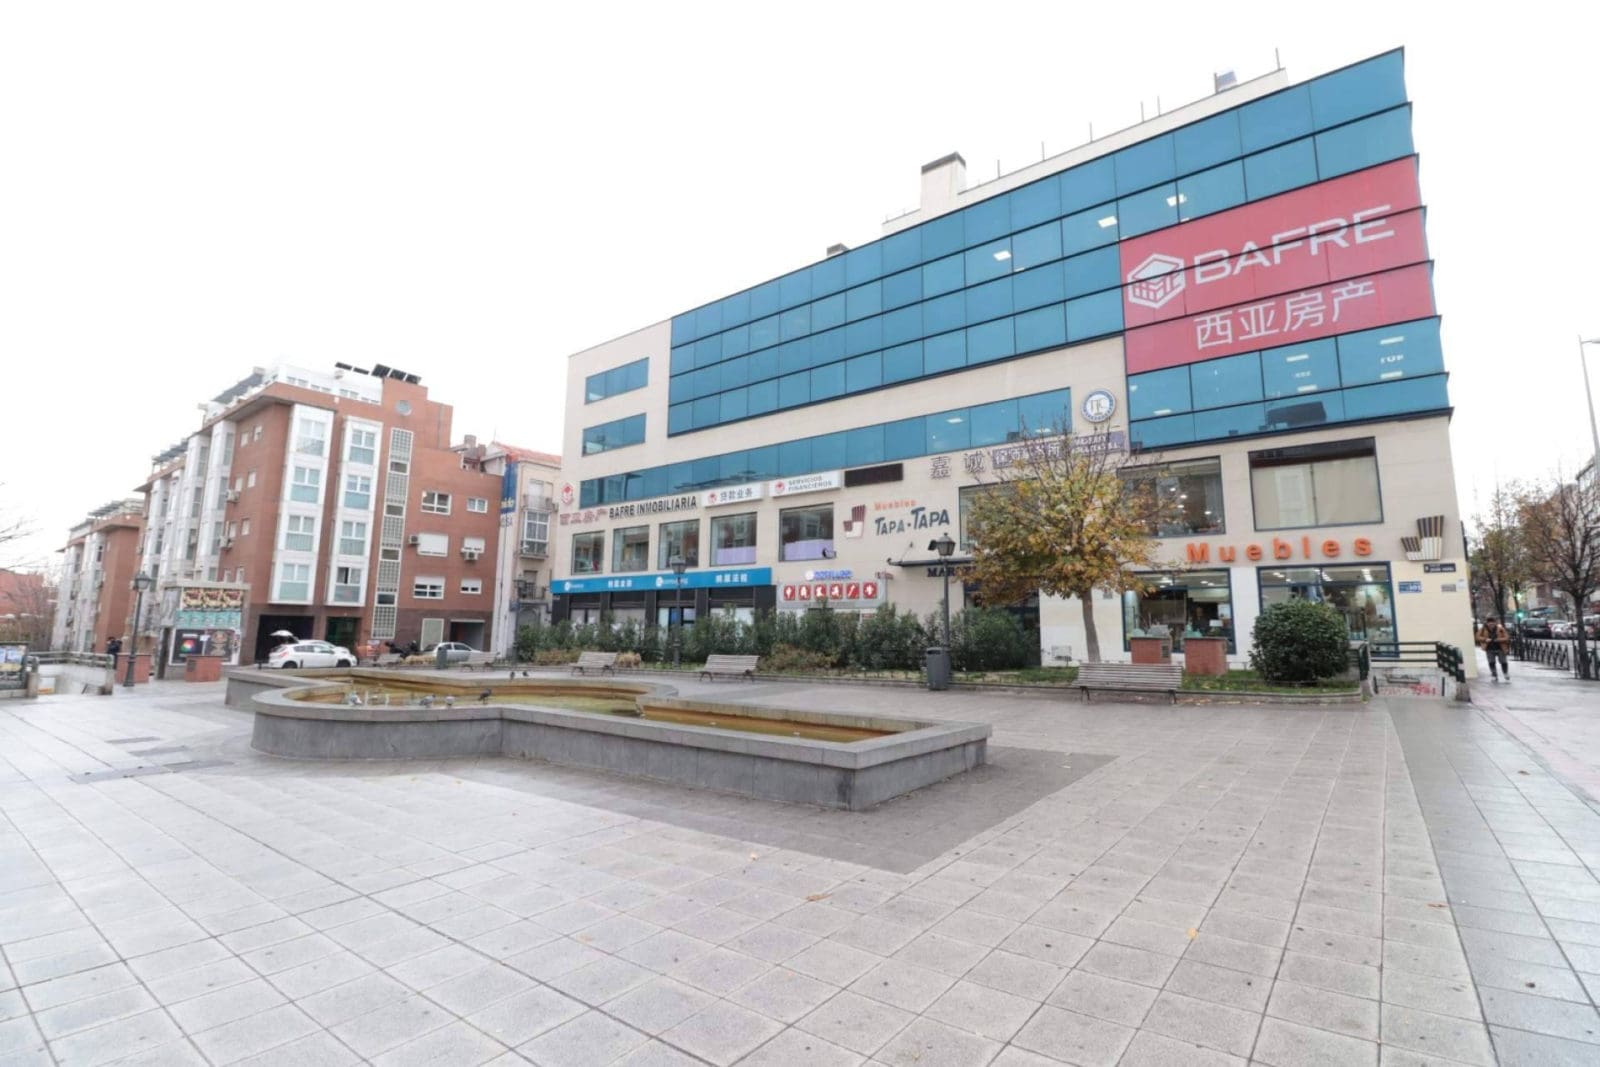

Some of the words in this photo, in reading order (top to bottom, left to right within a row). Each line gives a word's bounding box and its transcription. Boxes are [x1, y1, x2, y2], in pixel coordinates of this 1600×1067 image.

[1194, 204, 1396, 285] BAFRE
[1193, 280, 1376, 351] 西亚房产
[788, 475, 823, 486] SERVICIOS
[788, 480, 833, 492] FINANCIEROS
[719, 488, 753, 502] 贷款业务
[608, 504, 635, 519] BAFRE
[636, 496, 697, 516] INMOBILIARIA
[874, 500, 917, 511] Muebles
[1186, 535, 1373, 564] Muebles
